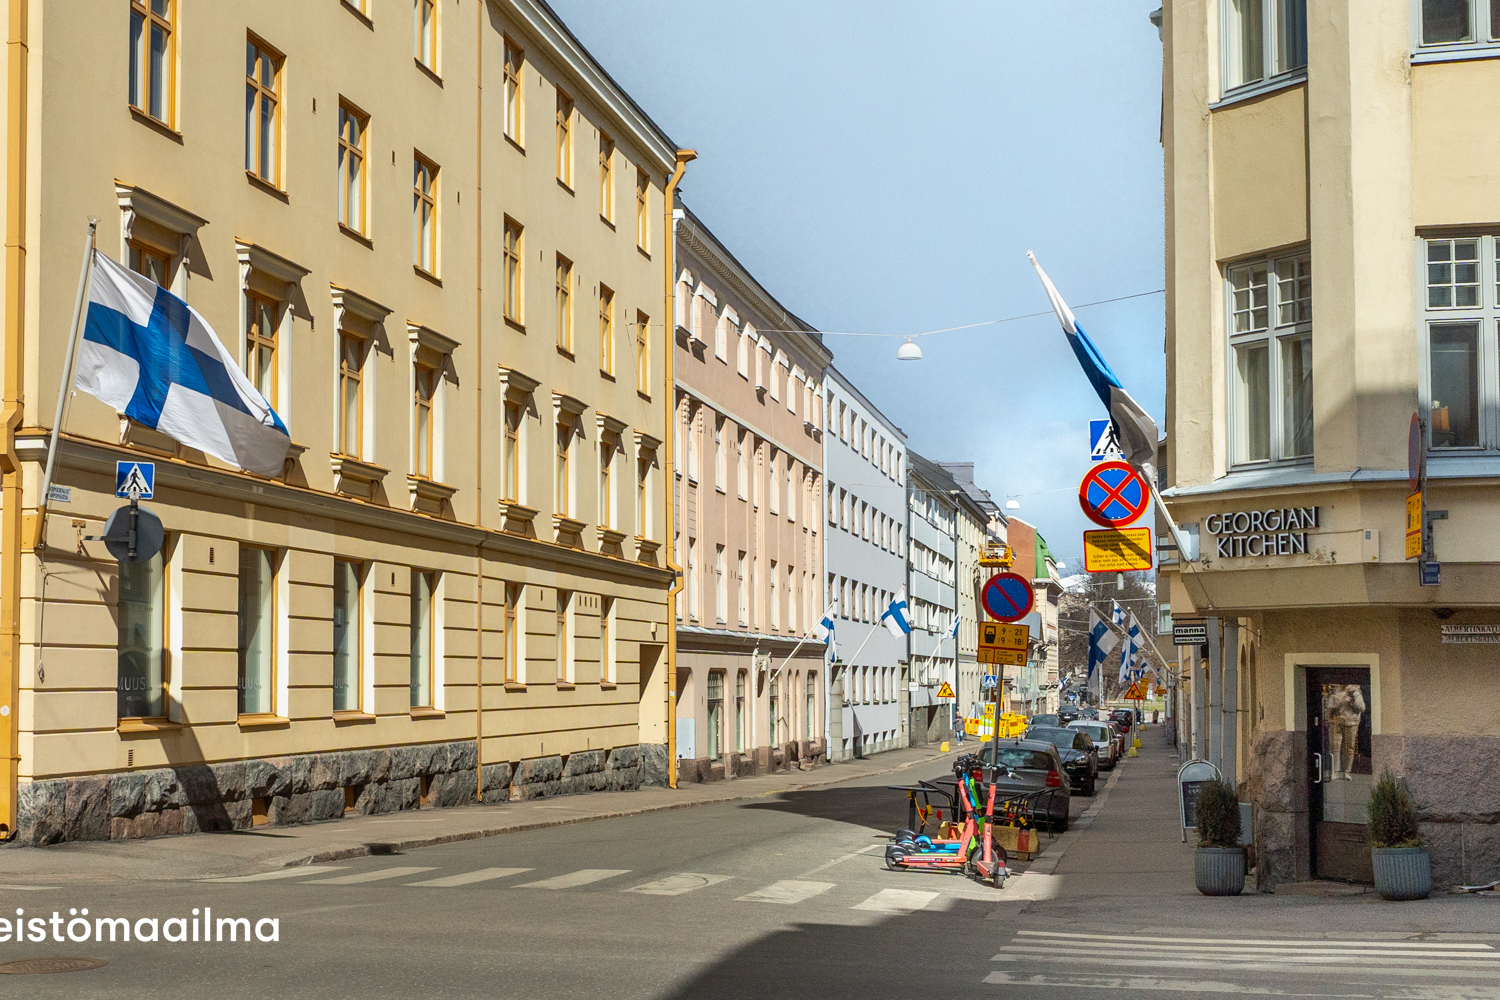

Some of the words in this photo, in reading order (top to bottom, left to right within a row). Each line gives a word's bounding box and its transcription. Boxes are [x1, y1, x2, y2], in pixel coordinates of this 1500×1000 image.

[1205, 506, 1317, 535] GEORGIAN
[1216, 532, 1306, 557] KITCHEN
[1001, 627, 1006, 635] 9
[1014, 628, 1023, 636] 21
[1017, 653, 1024, 663] B
